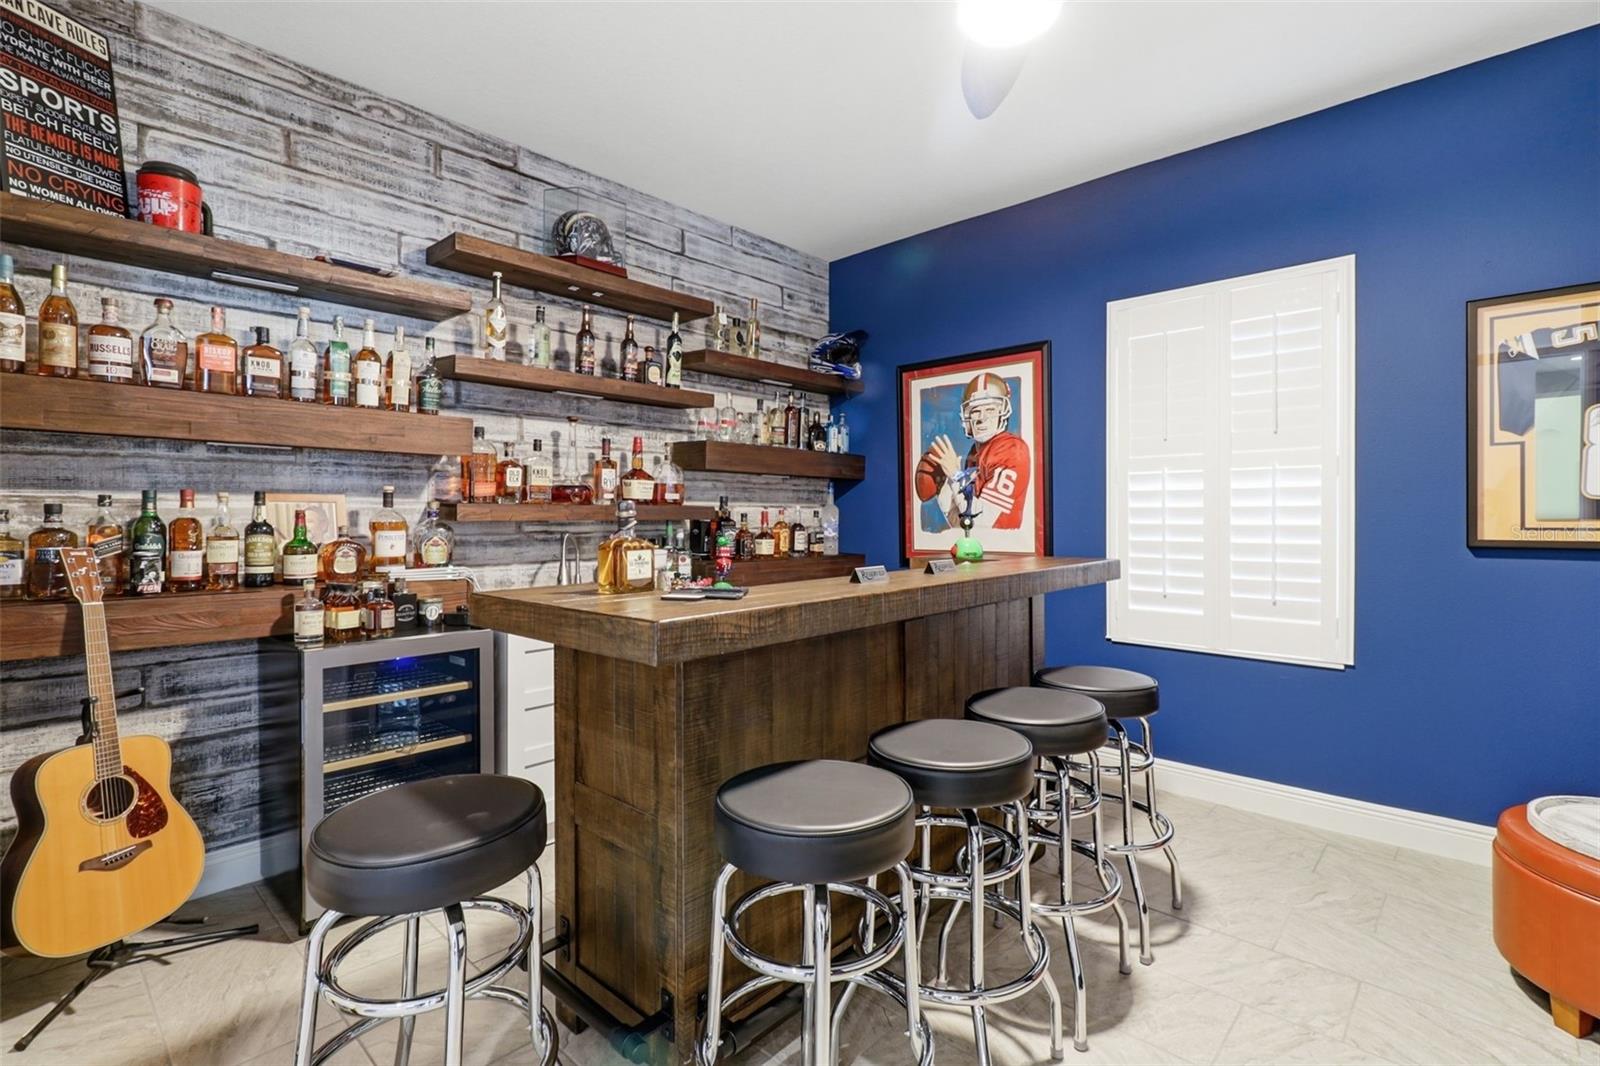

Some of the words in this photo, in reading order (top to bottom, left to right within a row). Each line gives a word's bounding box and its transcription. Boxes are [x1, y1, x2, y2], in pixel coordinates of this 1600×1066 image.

[18, 28, 65, 60] CHICK
[66, 52, 110, 82] FLICKS
[27, 1, 64, 34] CAVE
[66, 21, 107, 56] RULES
[52, 57, 81, 77] WITH
[82, 71, 112, 92] BEER
[0, 68, 117, 135] SPORTS
[1, 98, 58, 131] BELCH
[62, 123, 119, 155] FREELY
[4, 112, 28, 135] THE
[31, 121, 78, 157] REMOTE
[80, 144, 92, 161] IS
[93, 150, 120, 172] MINE
[4, 130, 74, 165] FLATULENCE
[76, 158, 121, 182] ALLOWED
[5, 145, 22, 157] NO
[75, 170, 95, 184] USE
[95, 177, 123, 194] HANDS
[8, 160, 42, 183] NO
[48, 175, 125, 213] CRYING
[8, 177, 28, 189] NO
[29, 183, 74, 206] WOMEN
[990, 466, 1018, 493] 16
